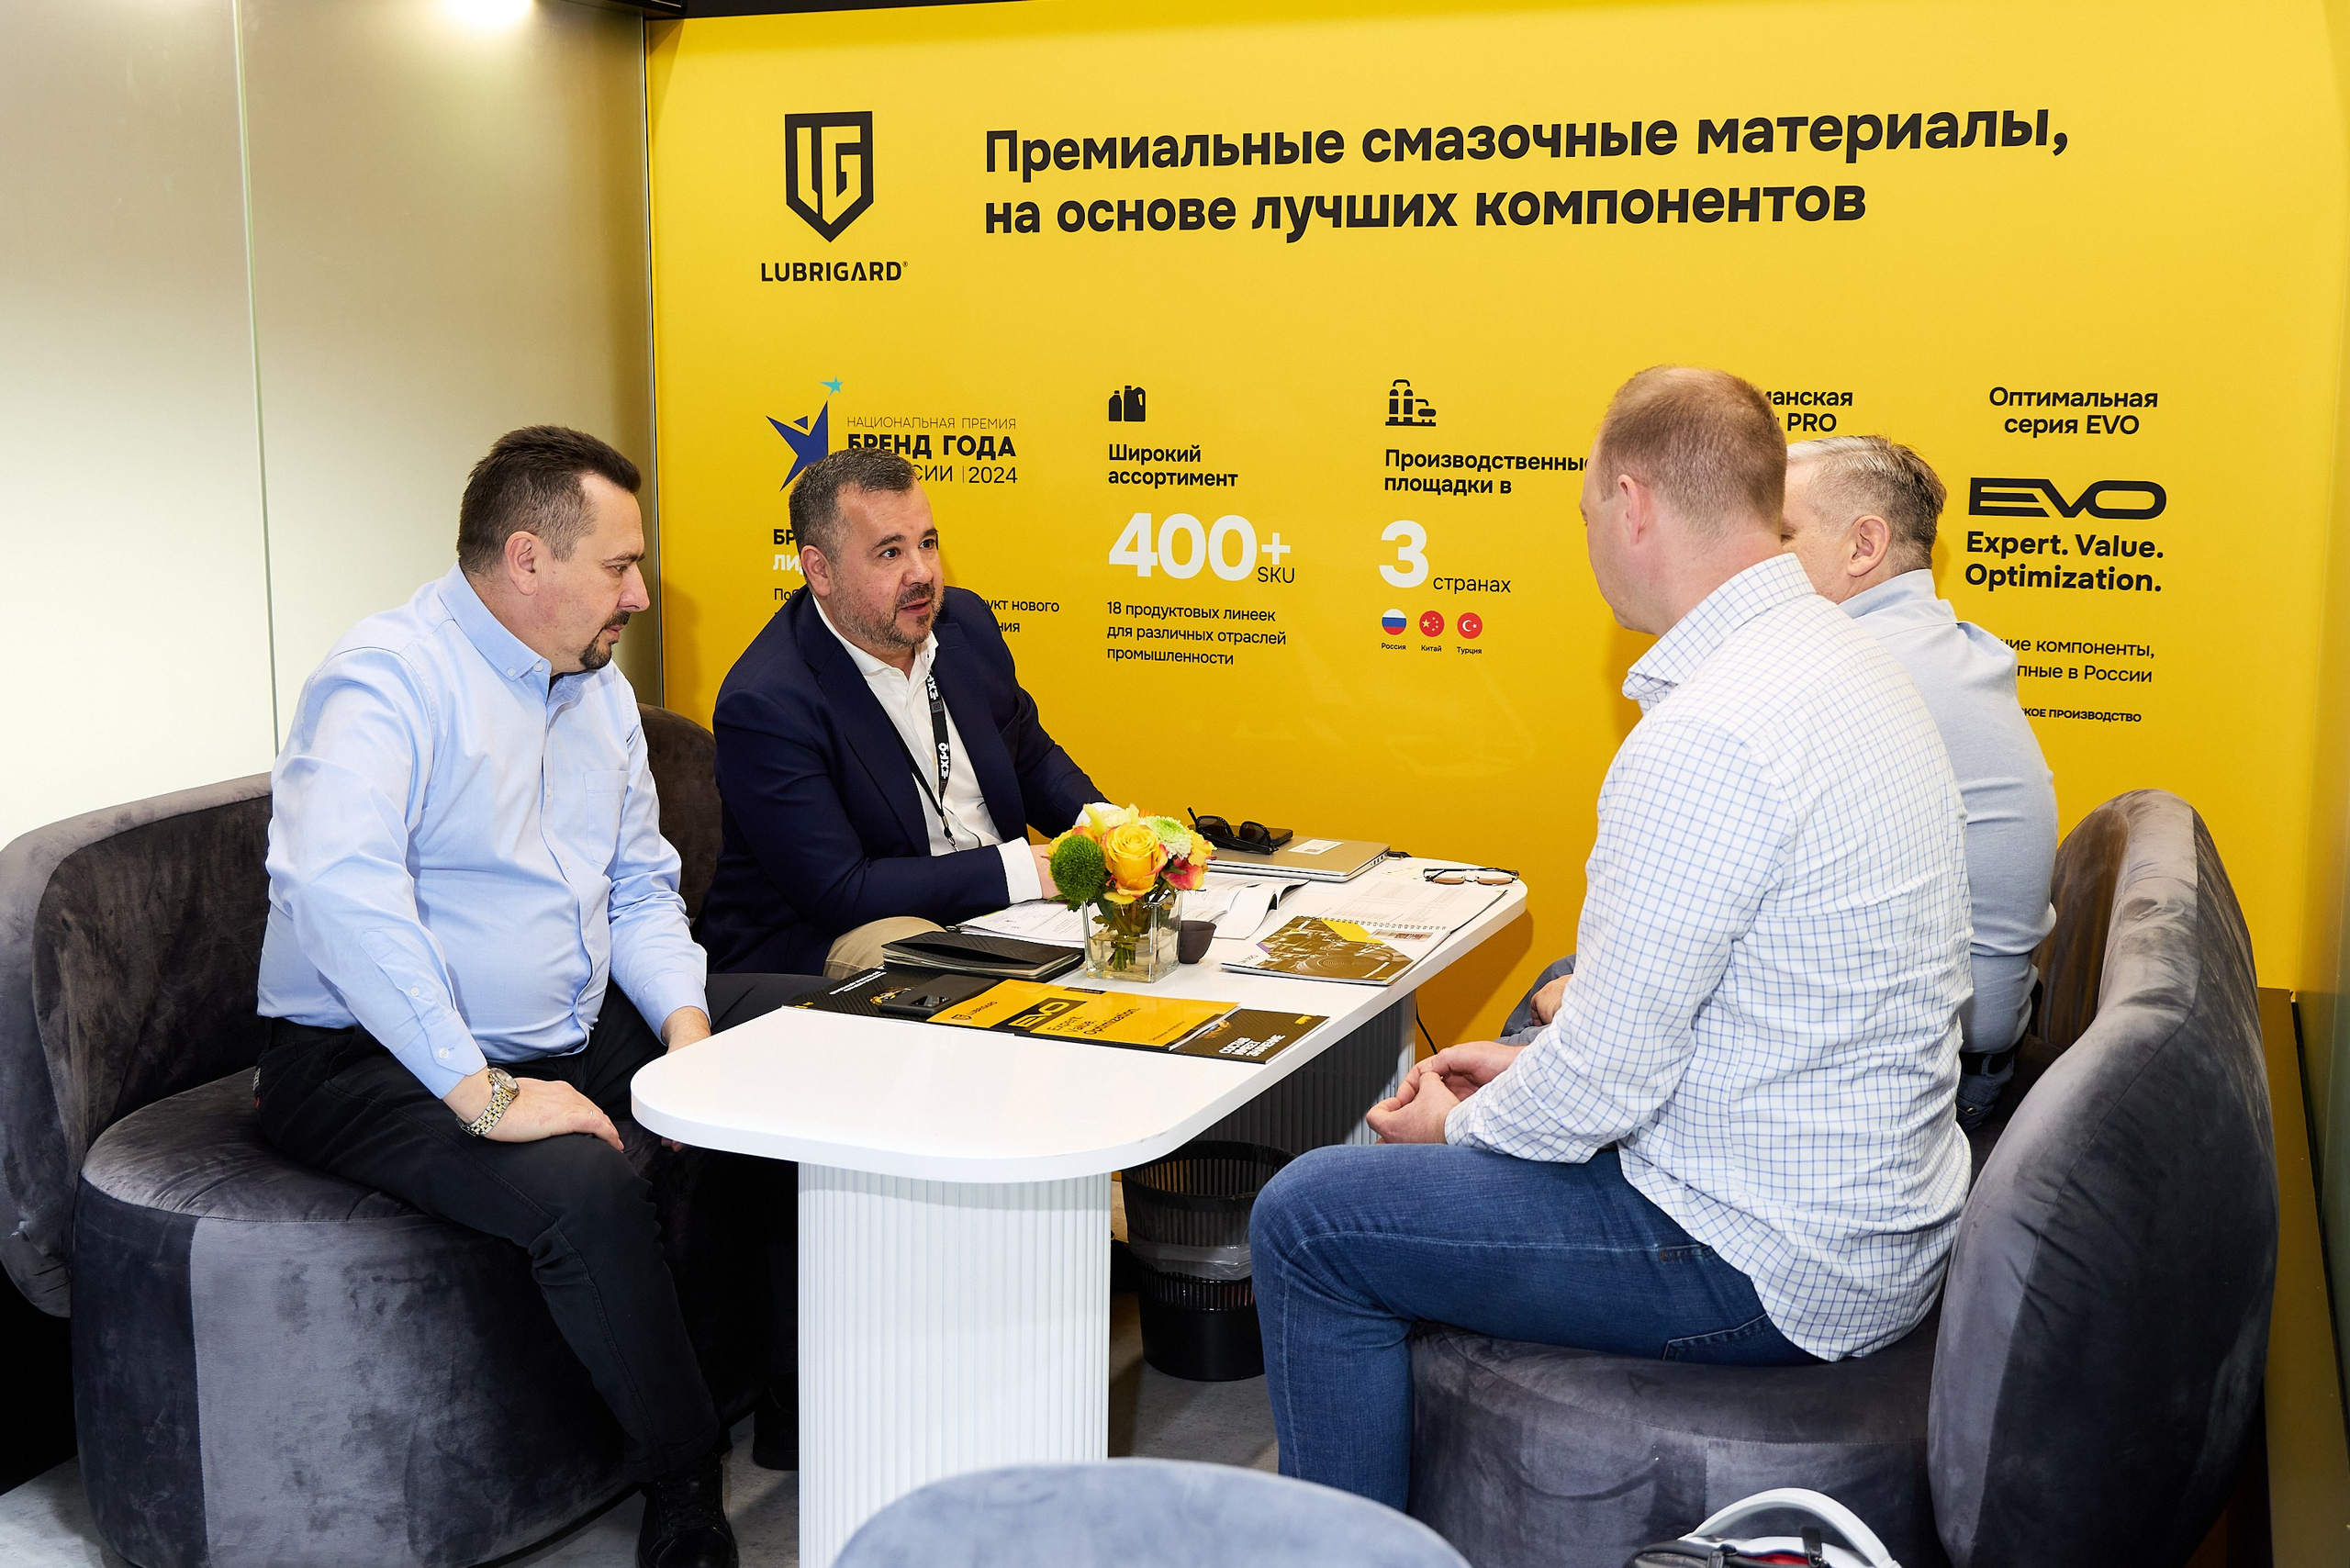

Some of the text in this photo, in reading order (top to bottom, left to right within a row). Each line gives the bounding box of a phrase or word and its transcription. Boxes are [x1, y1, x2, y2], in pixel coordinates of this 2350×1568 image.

[987, 109, 2067, 183] Премиальные смазочные материалы,
[986, 185, 1865, 243] на основе лучших компонентов
[1766, 391, 1852, 406] анская
[1989, 387, 2157, 408] Оптимальная
[847, 417, 1015, 429] НАЦИОНАЛЬНАЯ ПРЕМИЯ
[1787, 413, 1836, 431] PRO
[2005, 415, 2139, 438] серия EVO
[944, 435, 1016, 460] ГОДА
[1109, 444, 1201, 465] Широкий
[1385, 449, 1588, 472] Производственны
[969, 467, 1017, 483] 2024
[1109, 471, 1238, 489] ассортимент
[1385, 477, 1511, 496] площадки в
[1969, 477, 2166, 520] EVO
[1109, 513, 1294, 583] 400+ SKU
[1967, 532, 2163, 559] Expert. Value.
[773, 554, 803, 575] ЛИ
[1379, 521, 1510, 594] 3 странах
[1965, 564, 2161, 591] Optimization.
[1013, 601, 1059, 612] нового
[1107, 601, 1275, 622] 18 продуктовых линеек
[1107, 627, 1285, 645] для различных отраслей
[1108, 649, 1233, 665] промышленности
[2000, 639, 2154, 658] ие компоненты,
[2068, 668, 2077, 678] в
[2085, 666, 2152, 682] России
[2021, 708, 2142, 722] КОЕ ПРОИЗВОДСТВО
[1008, 1002, 1069, 1027] EVO
